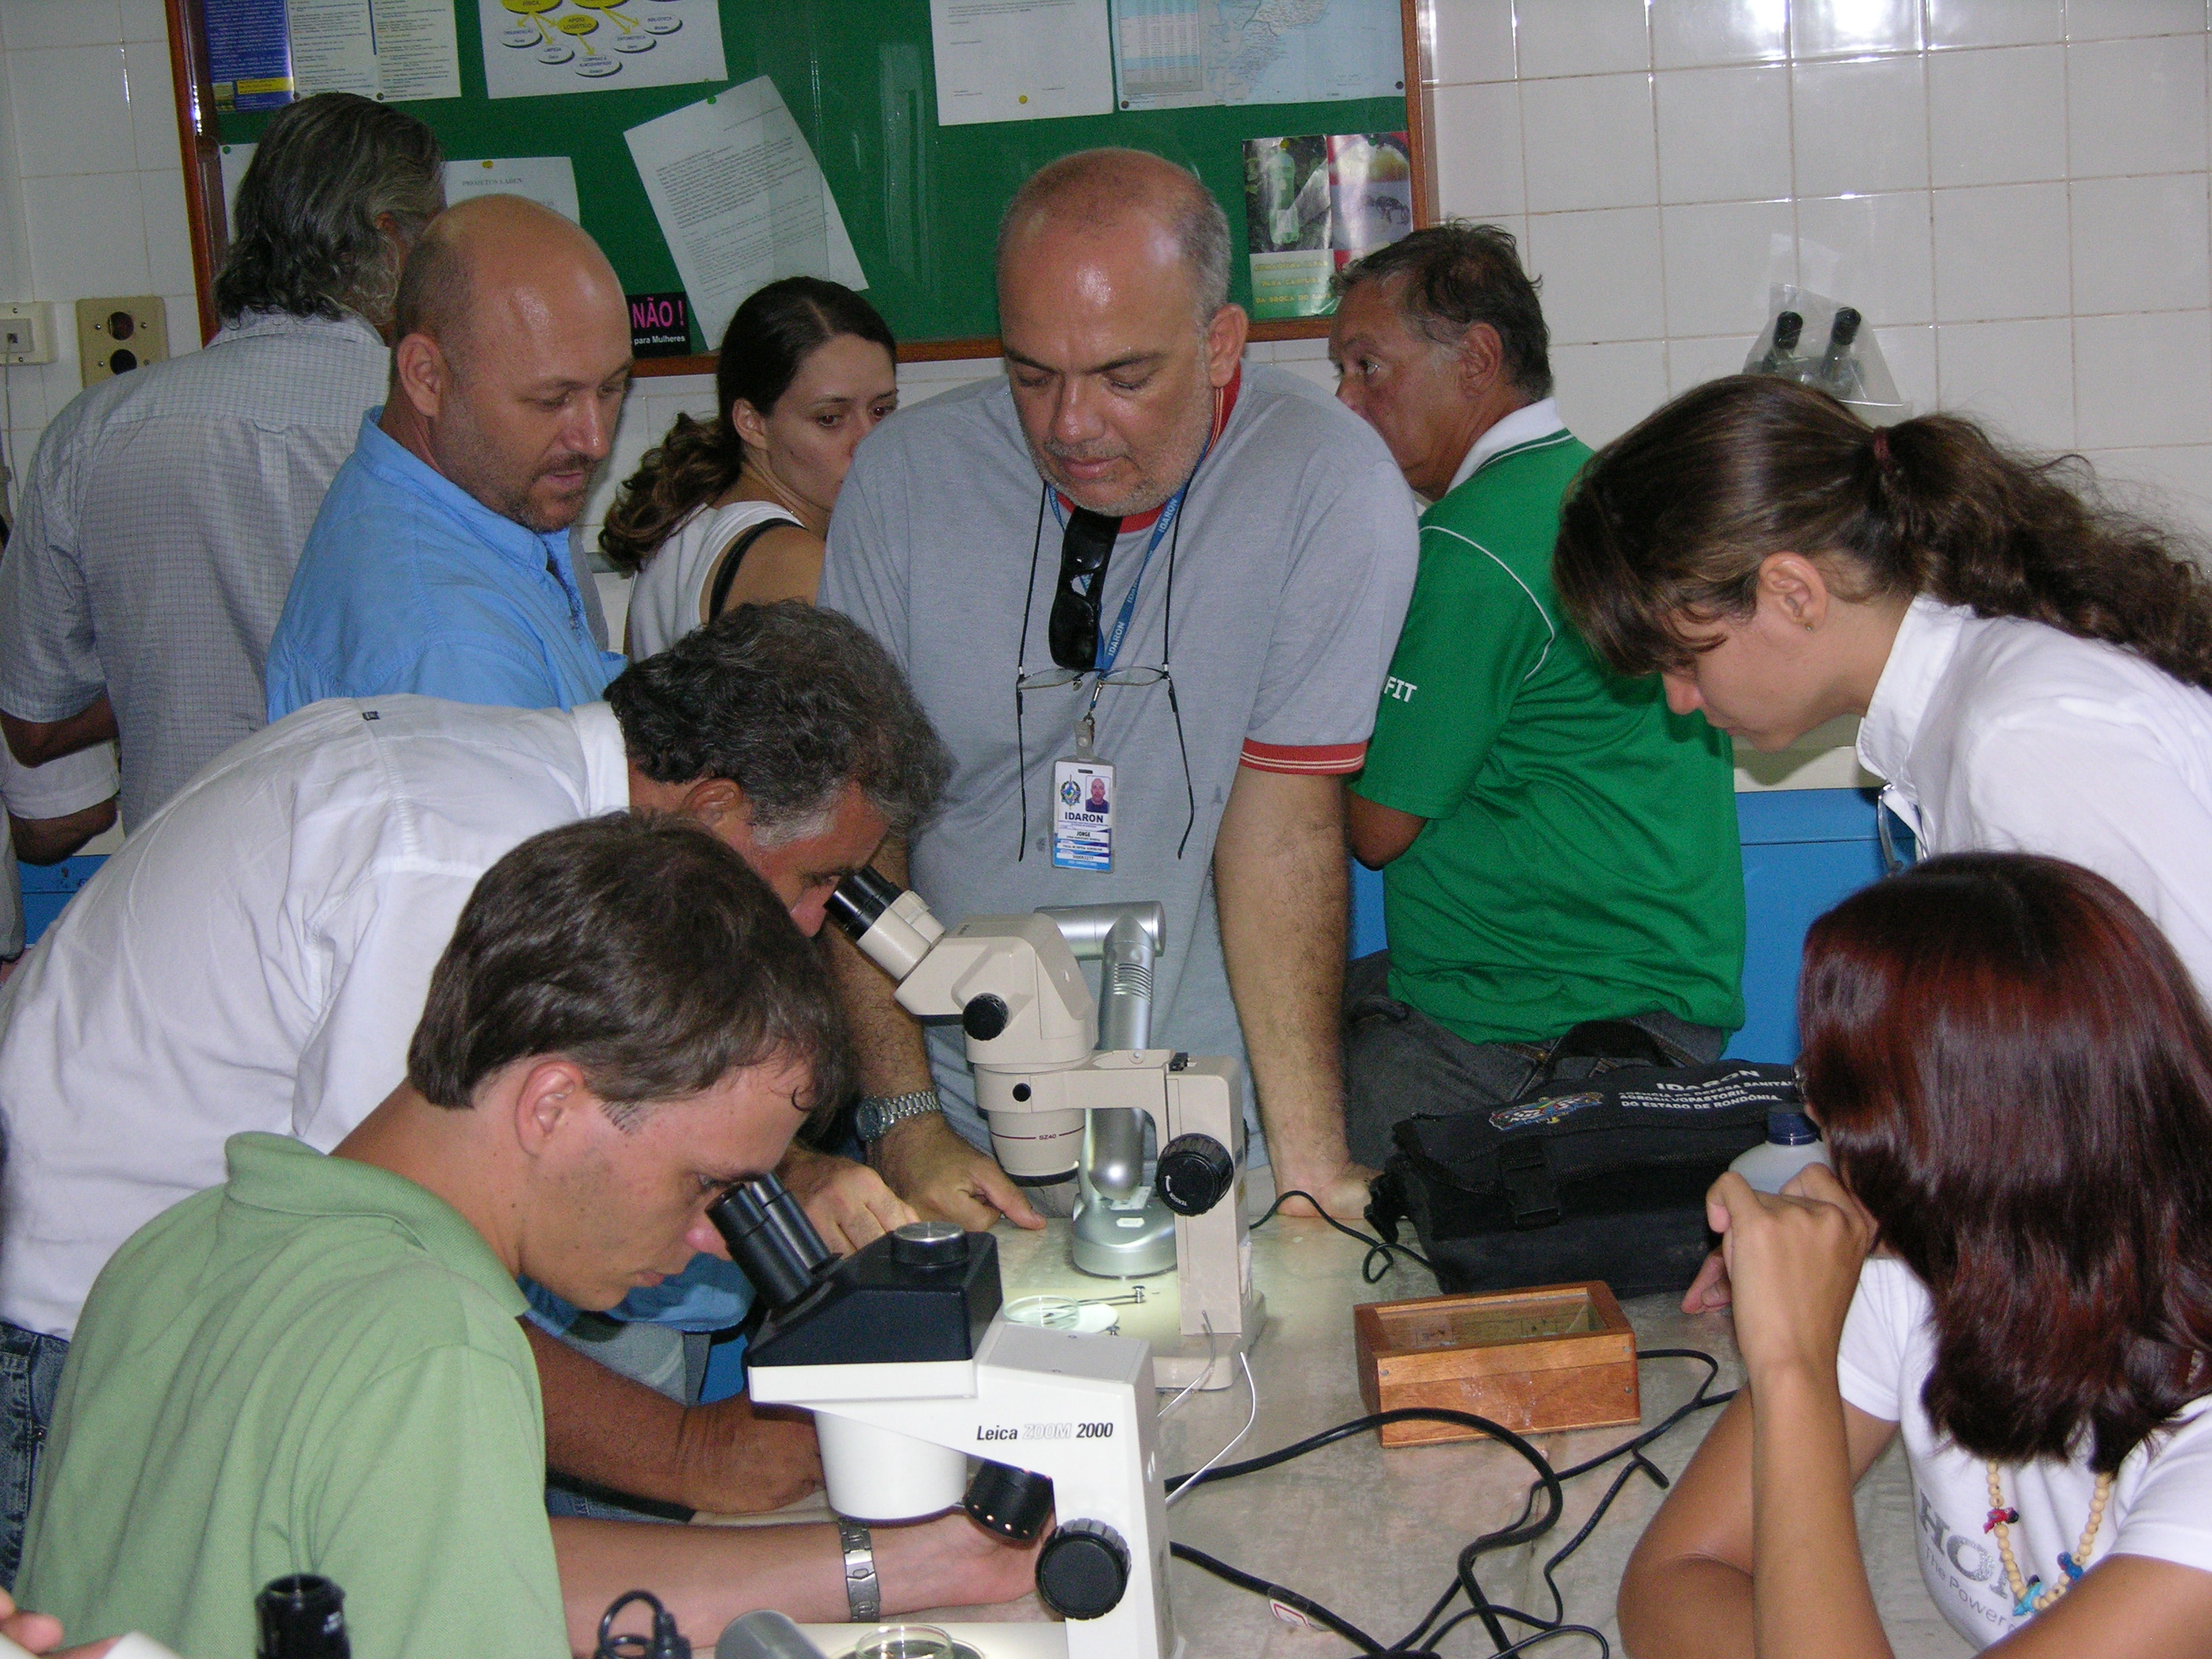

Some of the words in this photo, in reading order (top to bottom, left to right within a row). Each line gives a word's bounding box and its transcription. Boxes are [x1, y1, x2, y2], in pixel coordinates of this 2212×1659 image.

[634, 337, 651, 346] para
[651, 335, 686, 344] Mulheres
[1158, 497, 1178, 533] IDARON
[1107, 621, 1126, 658] IDARON
[1383, 676, 1418, 703] FIT
[1064, 811, 1104, 823] IDARON
[1656, 1069, 1760, 1091] IDARON
[1619, 1088, 1748, 1103] AGROSILVOPASTORIL
[1641, 1101, 1692, 1109] ESTADO
[1713, 1094, 1783, 1109] RONDÔNIA
[1168, 1192, 1187, 1206] TENSION
[977, 1425, 1018, 1441] Leica
[1022, 1423, 1072, 1440] ZOOM
[1076, 1422, 1114, 1438] 2000
[1924, 1542, 1946, 1580] The
[1948, 1575, 2007, 1626] Power
